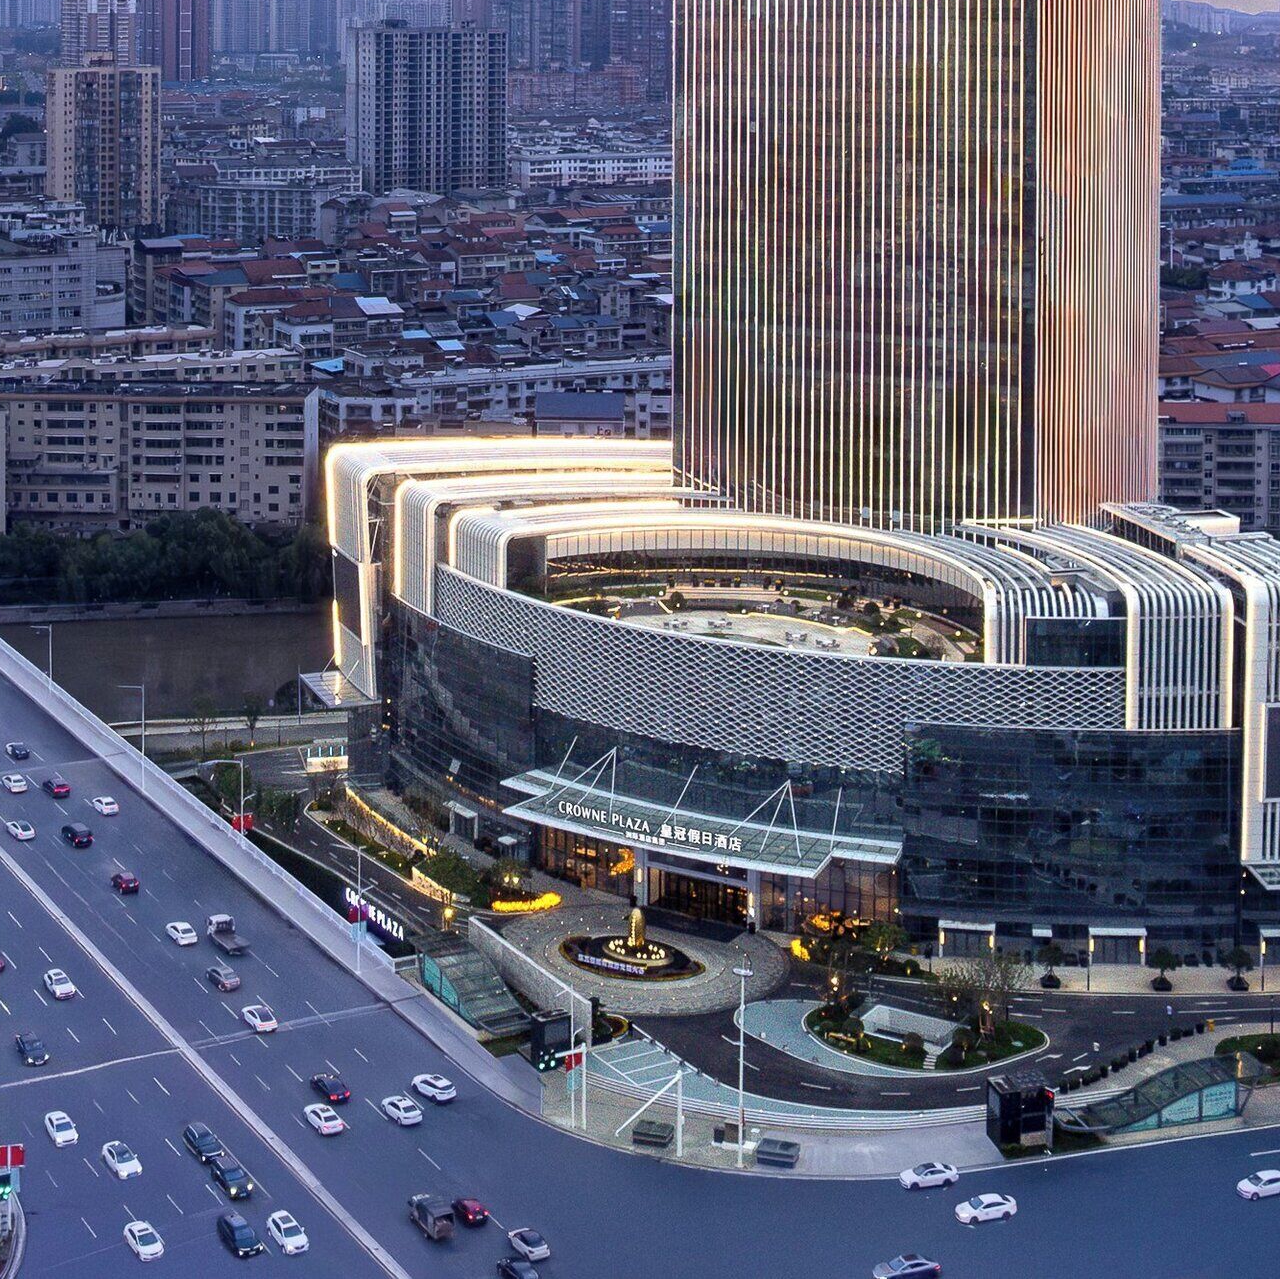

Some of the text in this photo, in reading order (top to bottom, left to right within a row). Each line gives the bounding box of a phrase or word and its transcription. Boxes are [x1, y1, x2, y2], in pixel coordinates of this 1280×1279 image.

[558, 801, 650, 833] CROWNE PLAZA
[660, 824, 742, 852] 皇冠假日酒店
[376, 909, 404, 941] PLAZA
